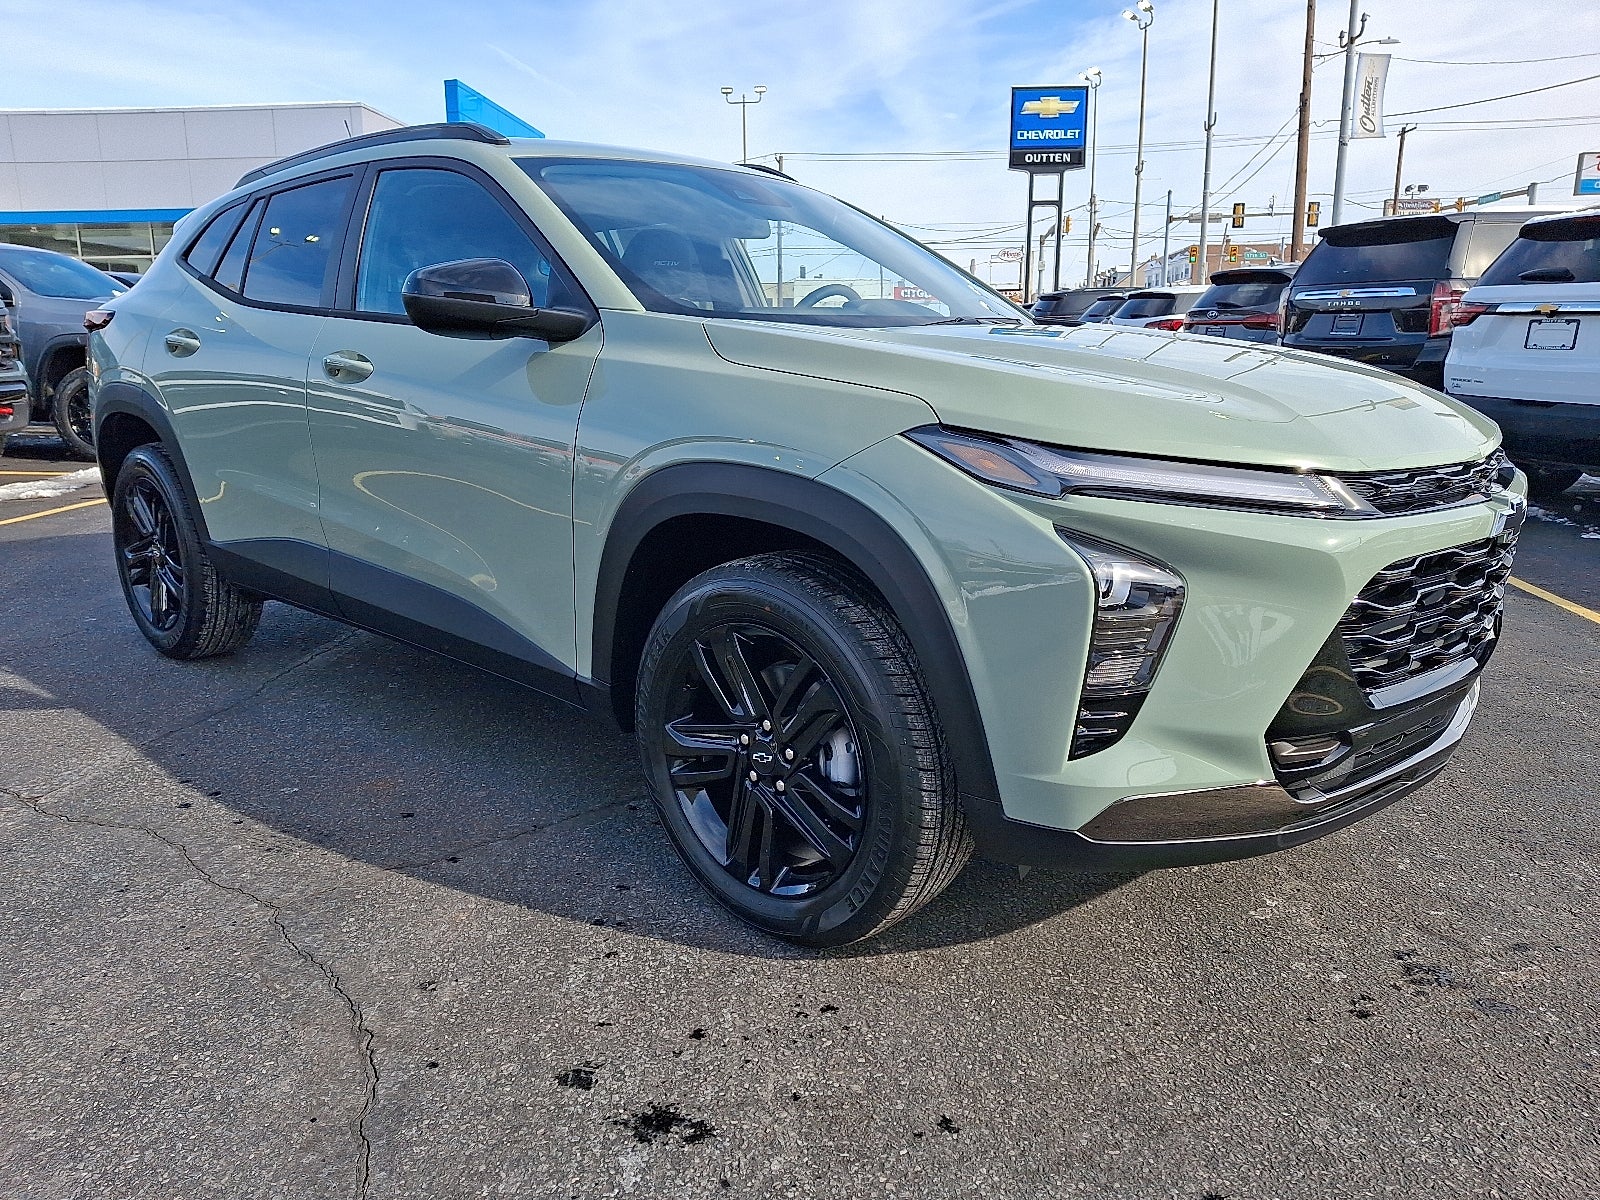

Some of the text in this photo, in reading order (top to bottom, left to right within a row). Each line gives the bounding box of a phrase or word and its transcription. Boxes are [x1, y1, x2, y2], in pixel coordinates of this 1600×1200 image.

[1359, 76, 1376, 133] Outten
[1017, 129, 1081, 140] CHEVROLET
[1024, 153, 1071, 163] OUTTEN
